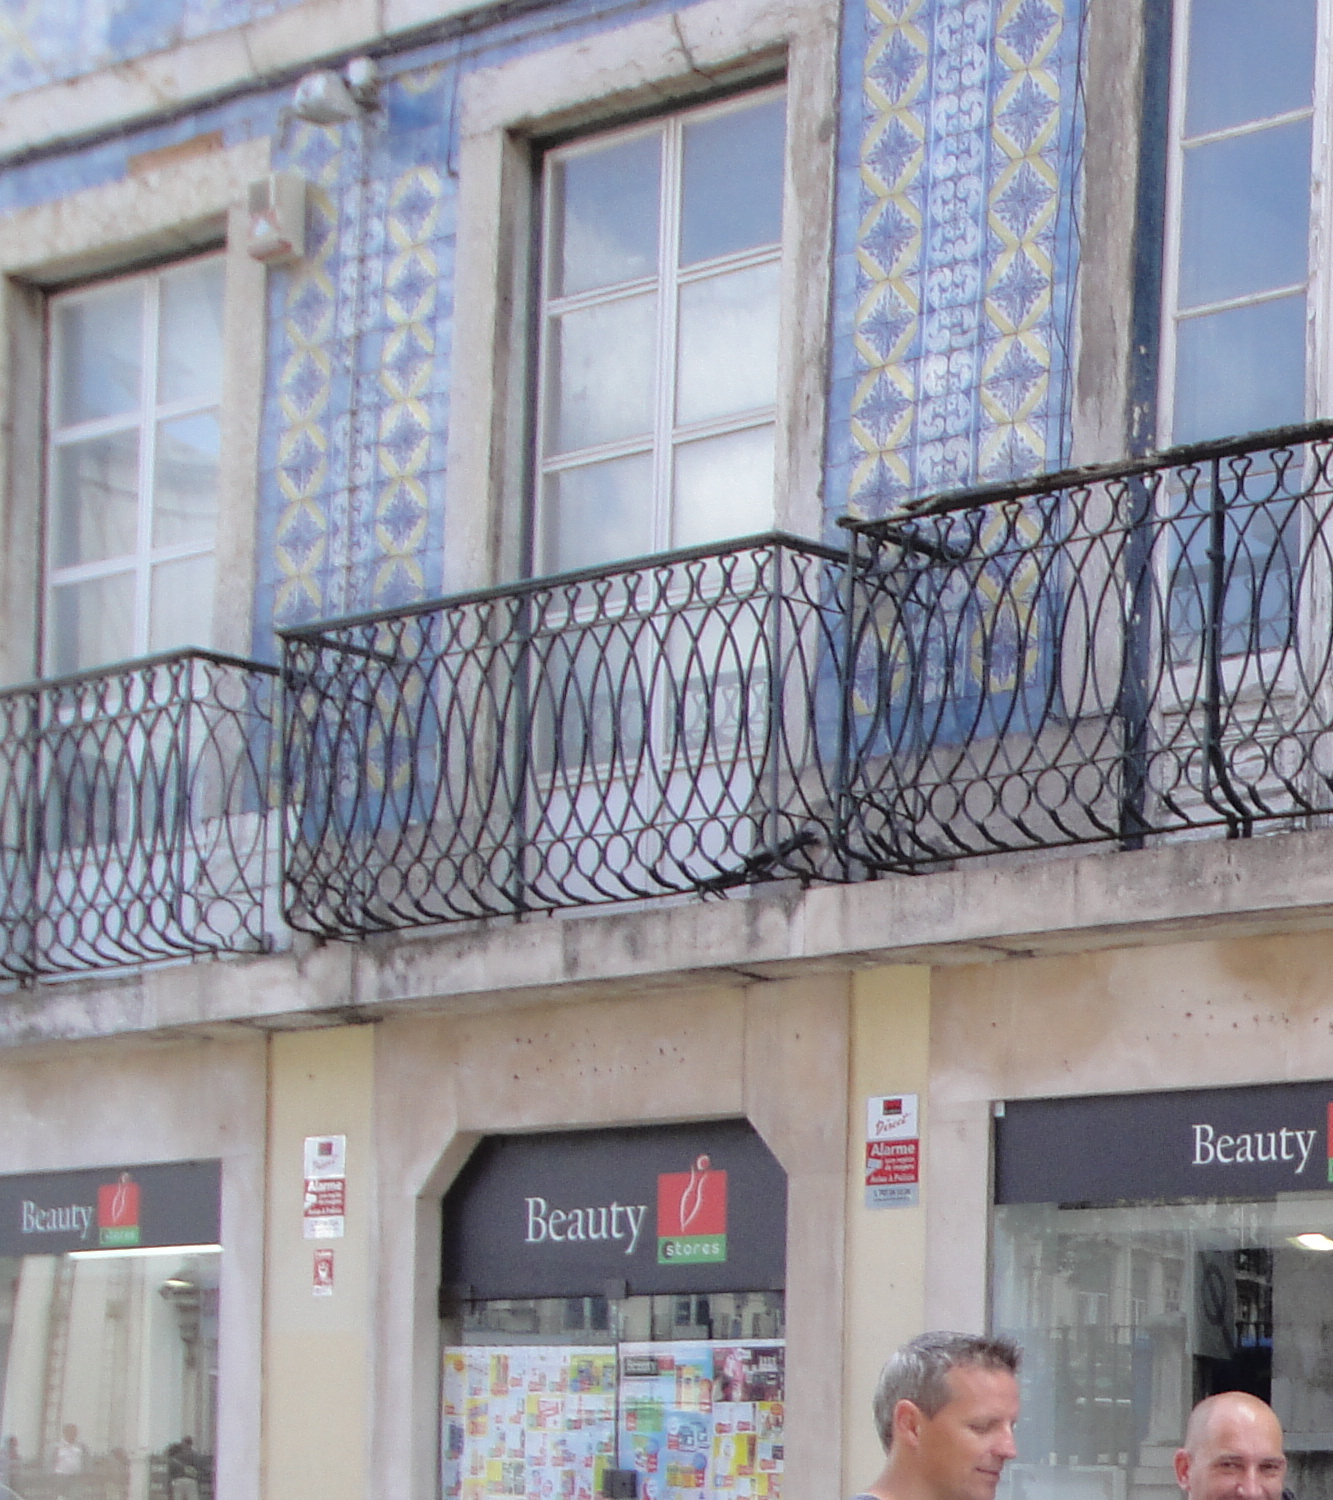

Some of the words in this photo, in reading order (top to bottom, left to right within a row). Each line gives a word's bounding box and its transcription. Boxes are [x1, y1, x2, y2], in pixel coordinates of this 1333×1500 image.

[870, 1143, 916, 1157] Alarme
[1191, 1123, 1317, 1174] Beauty
[22, 1199, 94, 1240] Beauty
[524, 1196, 648, 1254] Beauty
[665, 1240, 720, 1257] stores
